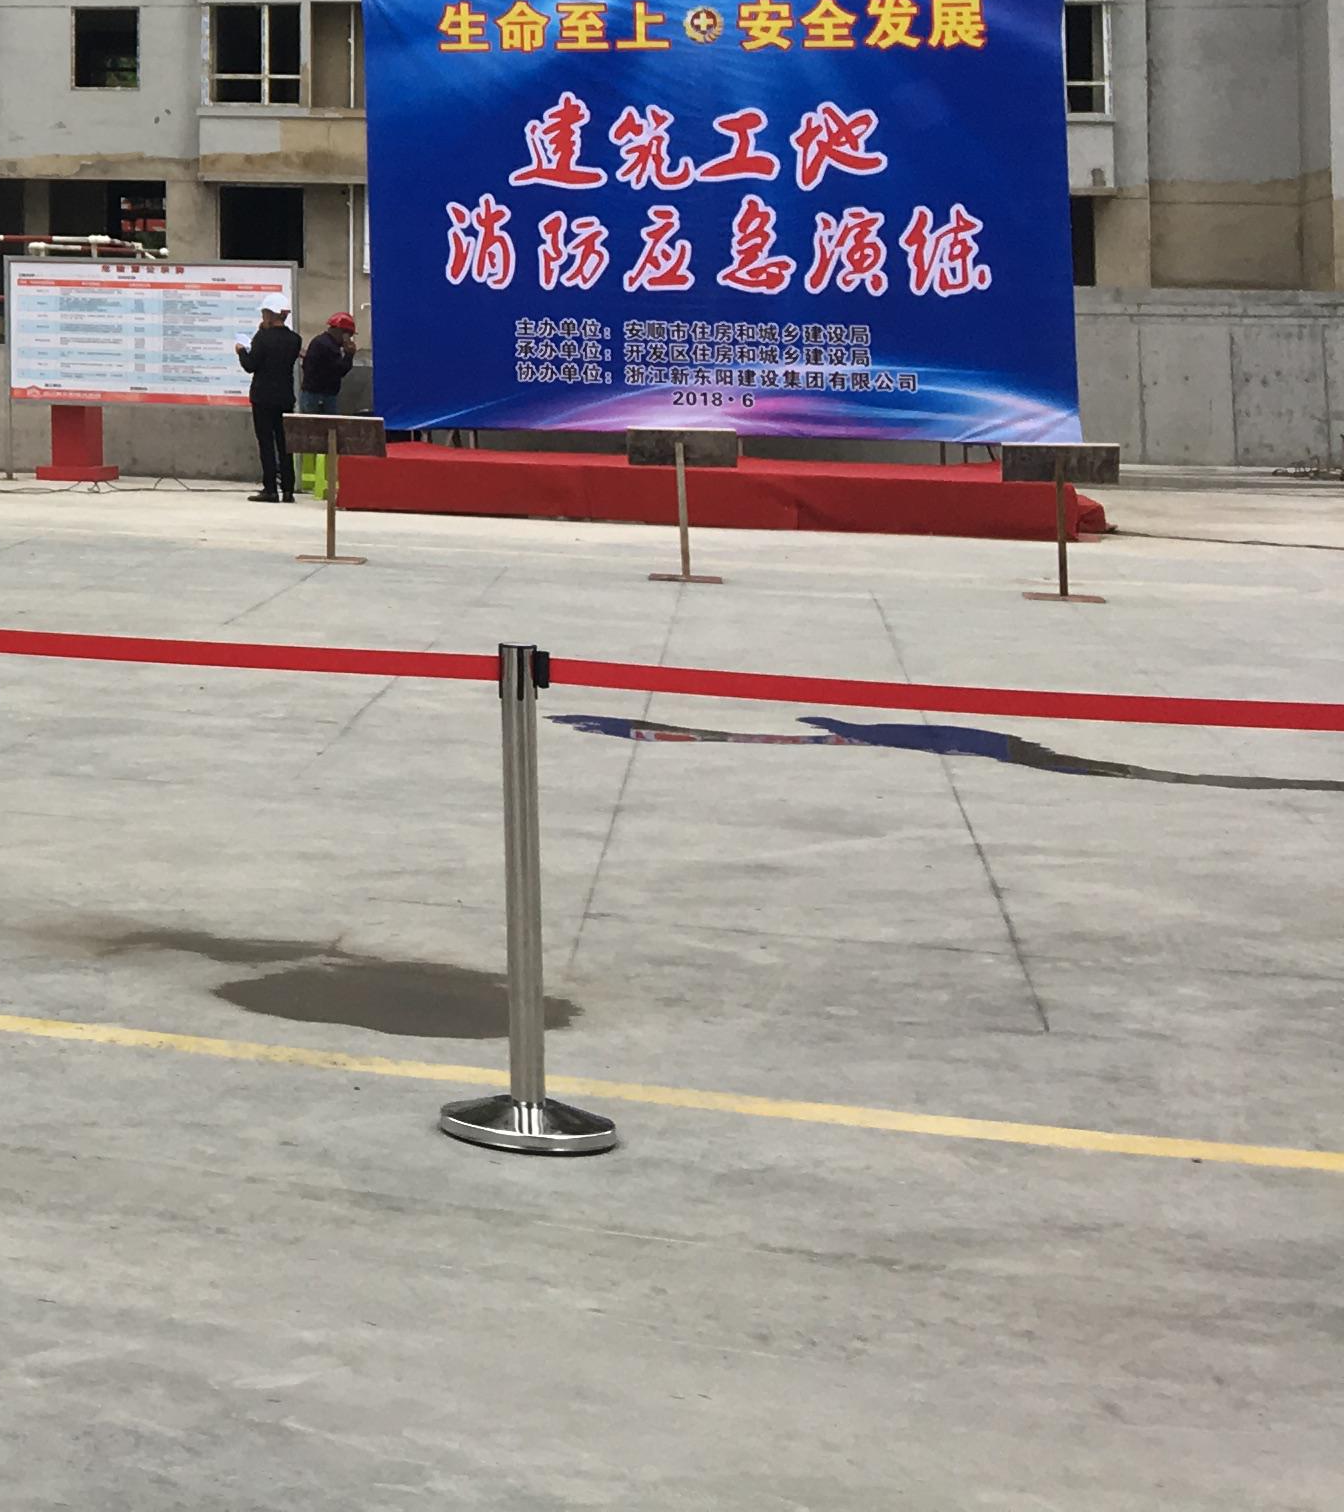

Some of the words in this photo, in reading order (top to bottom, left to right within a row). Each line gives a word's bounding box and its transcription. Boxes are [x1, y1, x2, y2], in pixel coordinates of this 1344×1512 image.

[438, 1, 672, 53] 生命至上
[509, 90, 889, 191] 建筑工地
[445, 192, 993, 298] 消防应急演练
[515, 318, 612, 341] 主办单位：
[623, 320, 872, 347] 安顺市住房和城乡建设局
[515, 339, 612, 363] 承办单位：
[623, 343, 872, 367] 开发区住房和城乡建设局
[515, 361, 612, 385] 协办单位：
[623, 365, 920, 394] 浙江新东阳建设集团有限公司
